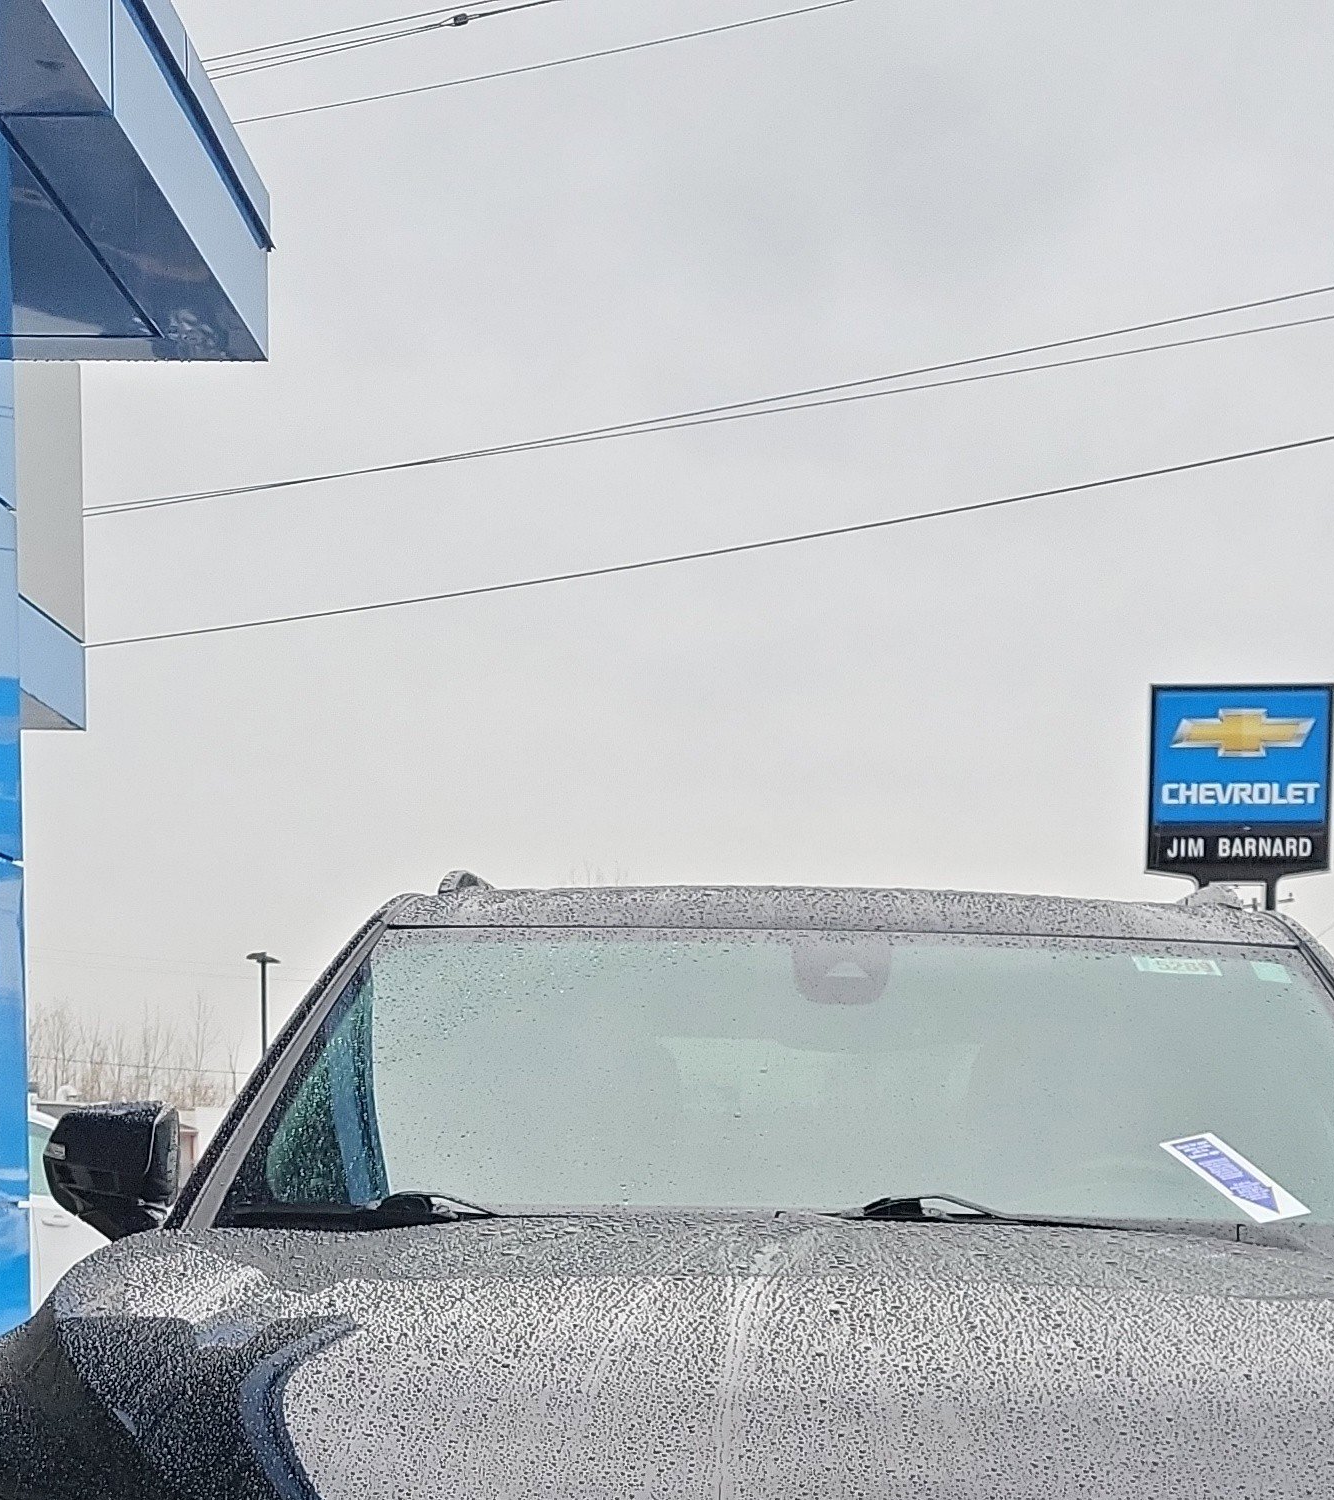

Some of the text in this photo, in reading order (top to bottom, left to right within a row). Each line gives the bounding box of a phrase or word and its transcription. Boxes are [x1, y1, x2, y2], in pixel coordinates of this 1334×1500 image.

[1161, 782, 1321, 805] CHEVROLET
[1167, 837, 1313, 858] JIM BARNARD
